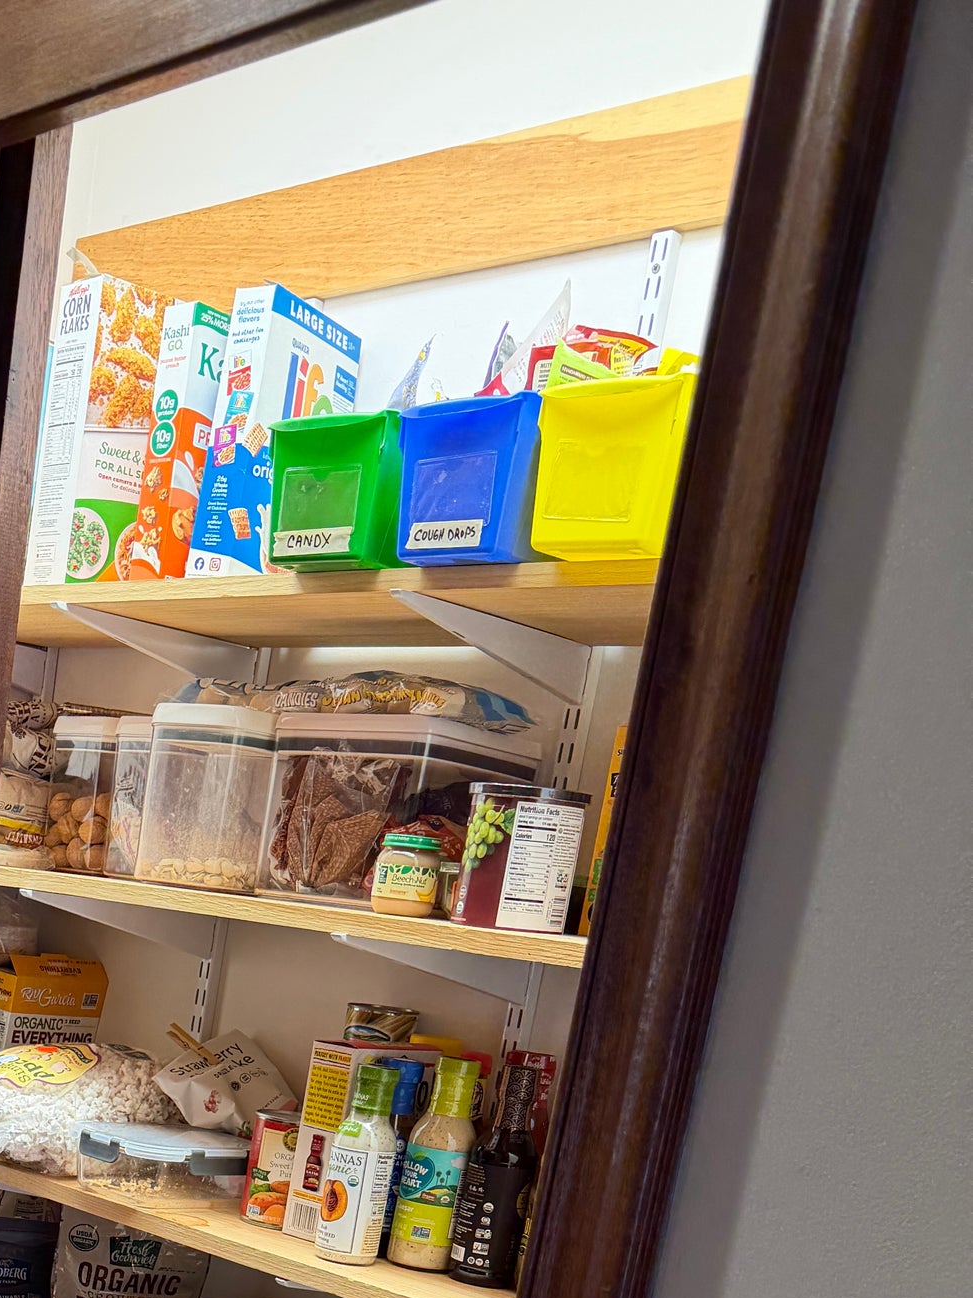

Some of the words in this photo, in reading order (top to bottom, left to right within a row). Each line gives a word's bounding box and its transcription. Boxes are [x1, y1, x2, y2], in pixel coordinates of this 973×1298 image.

[63, 294, 91, 318] CORN
[237, 306, 265, 315] delicious
[60, 314, 90, 335] FLAKES
[163, 323, 190, 340] Kashi
[290, 300, 324, 335] LARGE
[326, 324, 348, 351] SIZE
[159, 396, 175, 409] 10g
[155, 429, 171, 443] 10g
[99, 441, 131, 461] Sweet
[132, 450, 141, 465] &
[94, 459, 114, 472] FOR
[116, 465, 133, 477] ALL
[286, 532, 332, 549] CANDY
[413, 528, 445, 541] COUGH
[447, 526, 476, 541] DROPS
[275, 691, 319, 709] CANDIES
[519, 805, 545, 815] Nutrition
[546, 807, 560, 817] Facts
[515, 832, 533, 840] Calories
[14, 1015, 63, 1031] ORGANIC
[11, 1030, 93, 1045] EVERYTHING
[170, 1043, 244, 1076] Strawerry
[269, 1161, 290, 1169] Sweet
[76, 1230, 93, 1239] USDA
[120, 1241, 156, 1256] Fresh
[78, 1261, 181, 1296] ORGANIC
